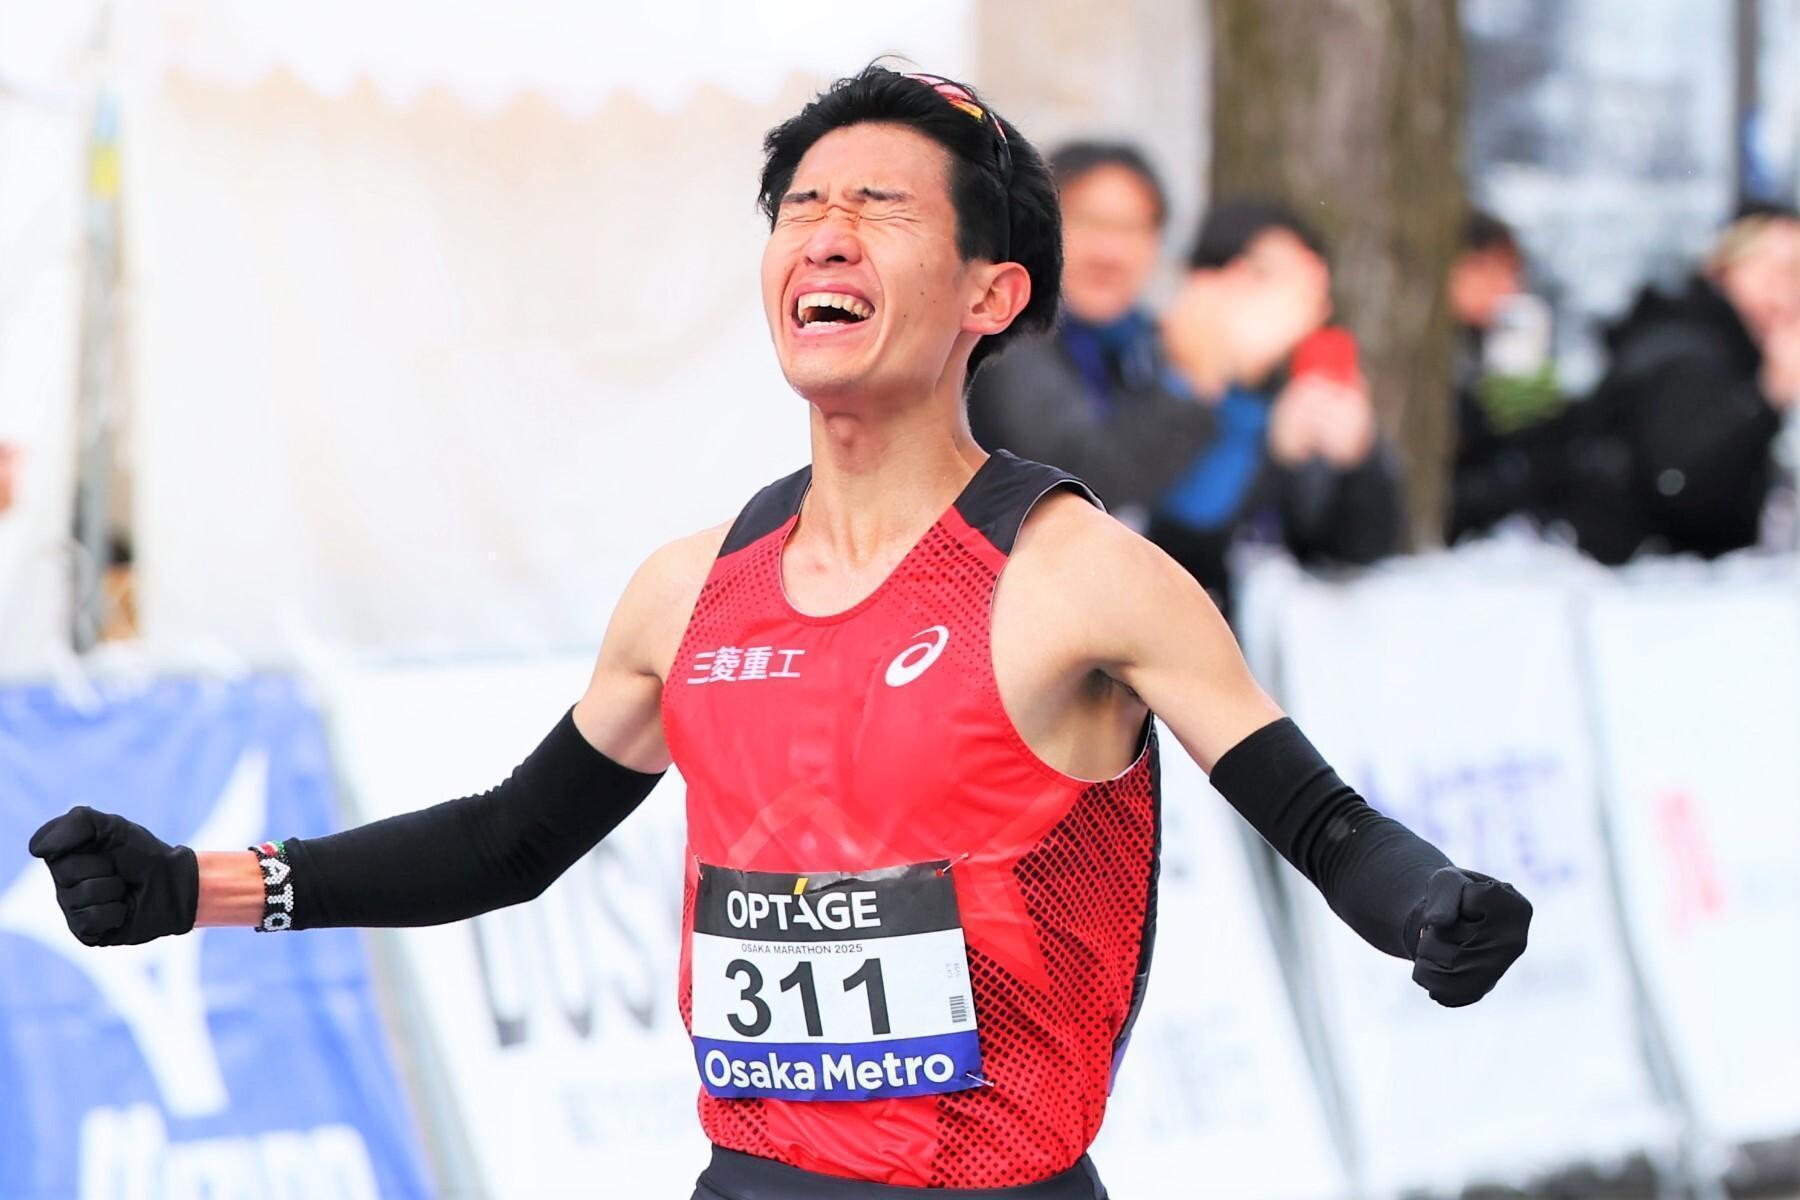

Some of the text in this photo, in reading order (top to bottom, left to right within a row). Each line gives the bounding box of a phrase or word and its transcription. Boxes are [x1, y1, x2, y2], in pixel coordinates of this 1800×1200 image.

[687, 646, 805, 685] 三菱重工
[741, 943, 863, 955] OSAKA MARATHON 2025
[725, 957, 891, 1038] 311
[704, 1049, 954, 1091] Osaka Metro
